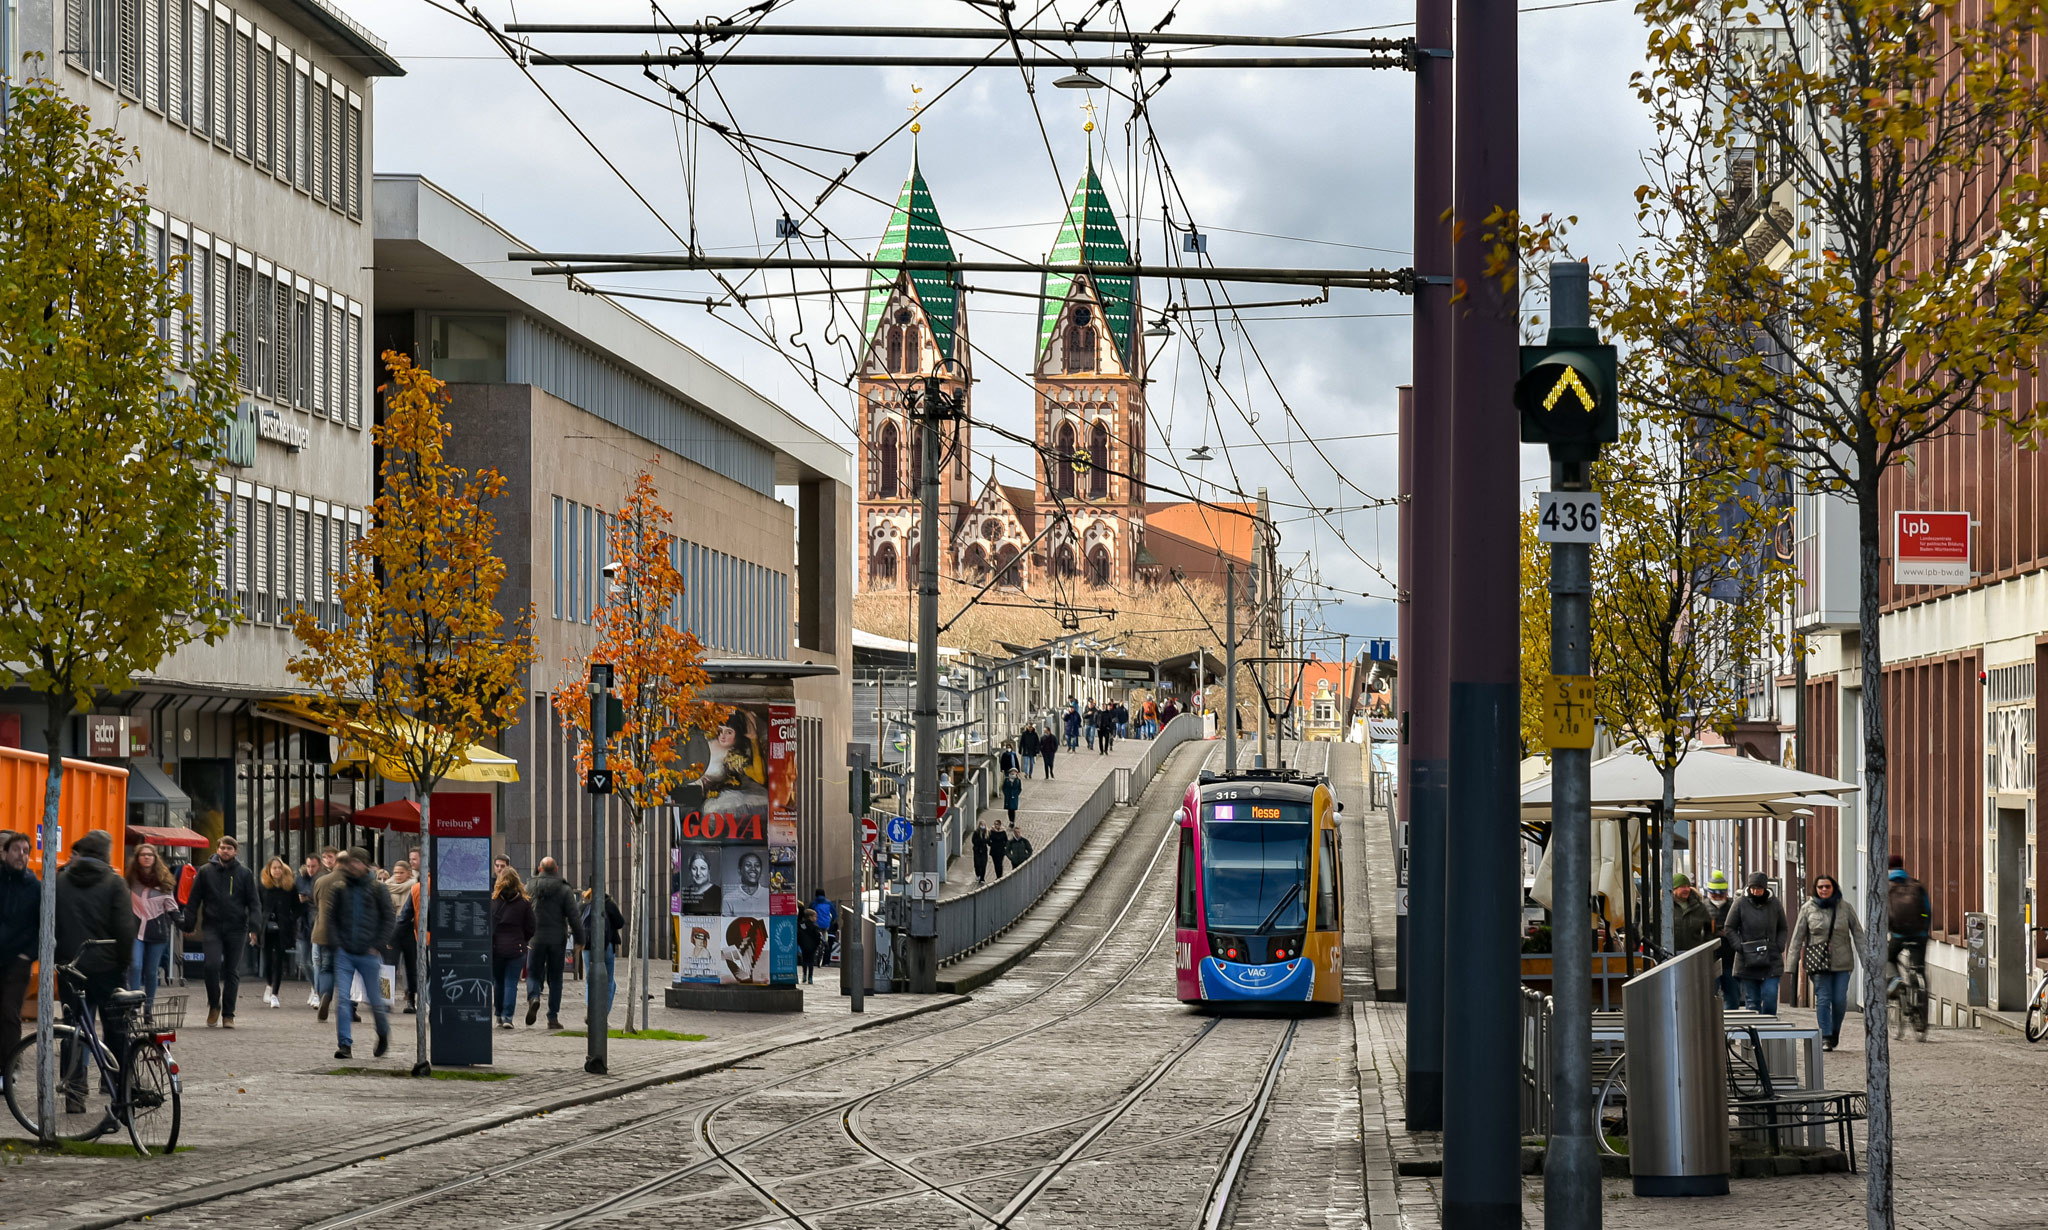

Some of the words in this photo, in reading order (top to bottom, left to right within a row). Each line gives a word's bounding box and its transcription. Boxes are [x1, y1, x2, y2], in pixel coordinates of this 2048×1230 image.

[258, 405, 310, 453] Versicherungen
[1542, 502, 1597, 532] 436
[1903, 518, 1930, 537] lpb
[1903, 568, 1964, 577] www.lpb-bw.de
[1560, 683, 1569, 698] S
[95, 719, 115, 743] adco
[1216, 791, 1237, 799] 315
[1252, 806, 1280, 819] Messe
[437, 819, 473, 830] Freiburg
[683, 811, 763, 840] GOYA
[1247, 967, 1266, 977] VAG
